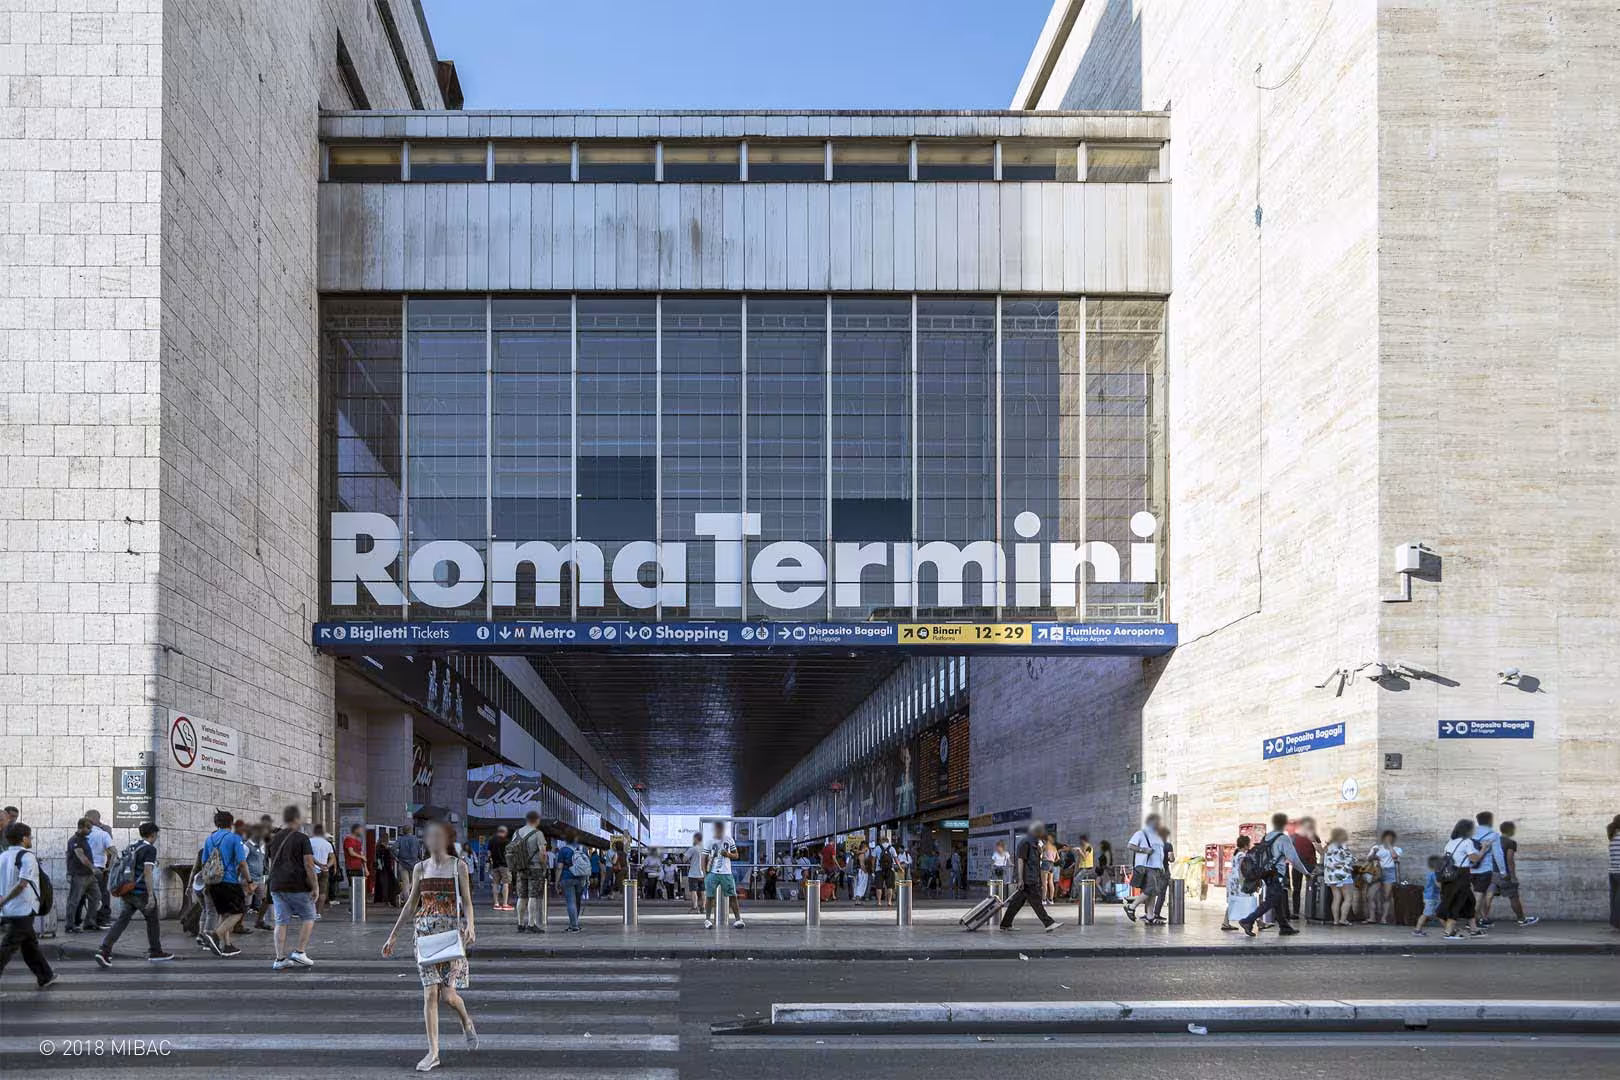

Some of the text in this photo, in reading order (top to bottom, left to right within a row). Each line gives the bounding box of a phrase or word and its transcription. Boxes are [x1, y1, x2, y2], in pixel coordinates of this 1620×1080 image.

[350, 626, 450, 641] Biglietti Tickets
[530, 626, 576, 639] Metro
[655, 626, 729, 641] Shopping
[808, 626, 893, 636] Deposito Bagagli
[933, 626, 962, 635] Binari
[1065, 626, 1165, 638] Fiumicino Aeroporto
[1471, 721, 1530, 730] Deposito Bagagli
[1286, 724, 1343, 745] Deposito Bagagli
[473, 773, 541, 807] Ciao
